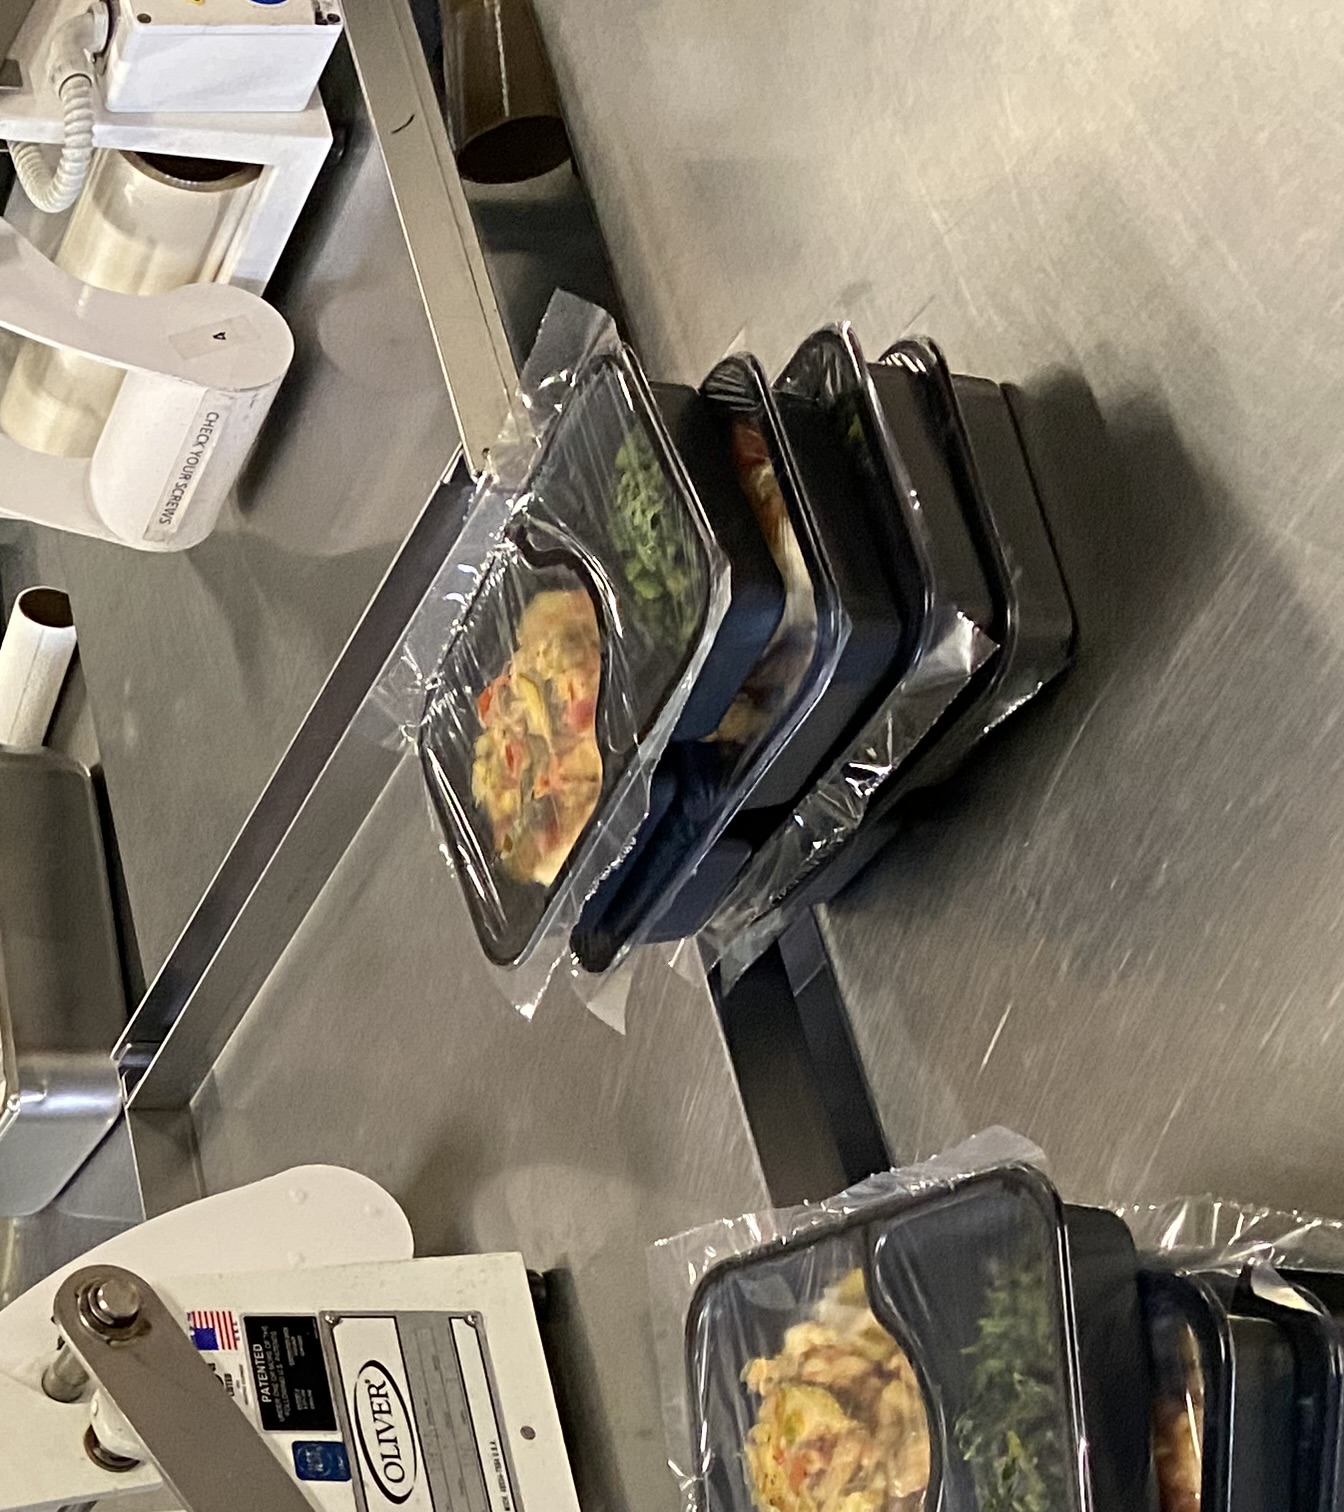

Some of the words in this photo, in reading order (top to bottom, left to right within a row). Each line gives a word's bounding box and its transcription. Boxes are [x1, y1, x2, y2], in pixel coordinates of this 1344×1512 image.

[196, 412, 220, 448] CHECK
[178, 451, 202, 480] YOUR
[158, 482, 189, 525] SCREWS
[253, 1343, 272, 1403] PATENTED
[367, 1380, 405, 1483] OLIVER
